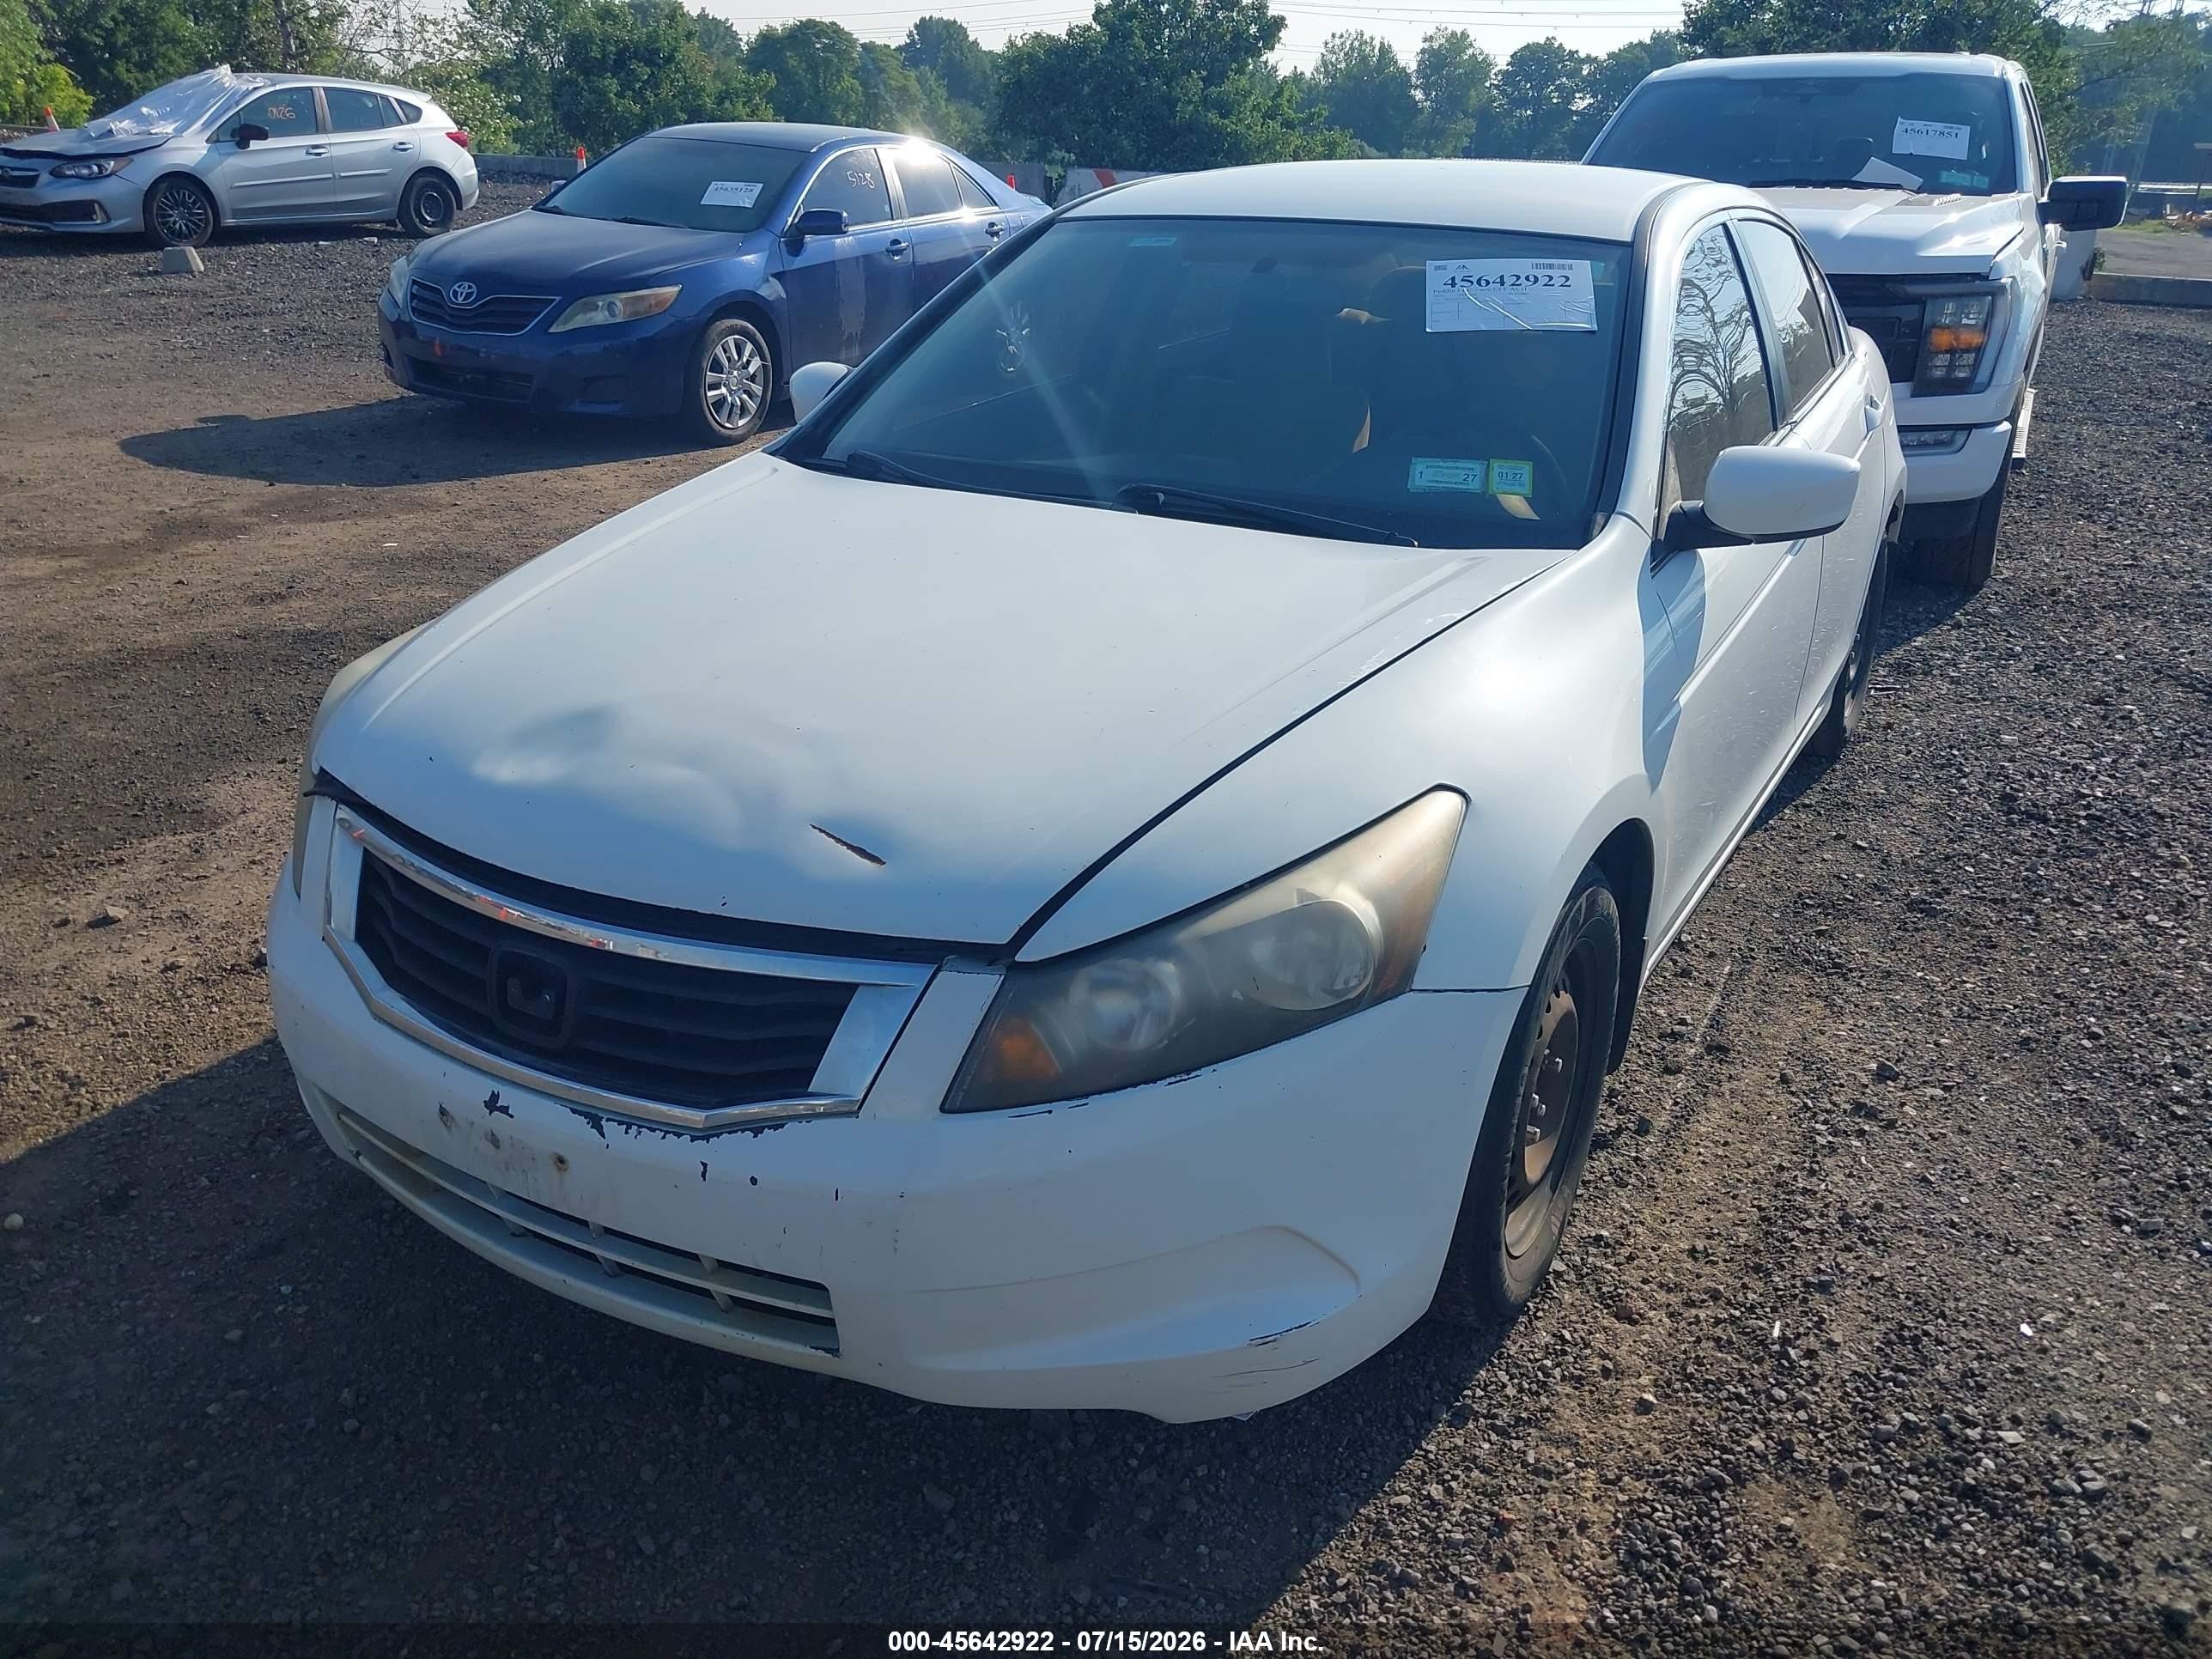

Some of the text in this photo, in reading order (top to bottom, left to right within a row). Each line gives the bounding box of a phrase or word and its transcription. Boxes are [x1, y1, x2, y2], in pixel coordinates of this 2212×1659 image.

[1902, 128, 1959, 138] 45617851
[846, 171, 875, 189] 5128
[1443, 274, 1572, 289] 45642922
[1462, 473, 1478, 483] 27
